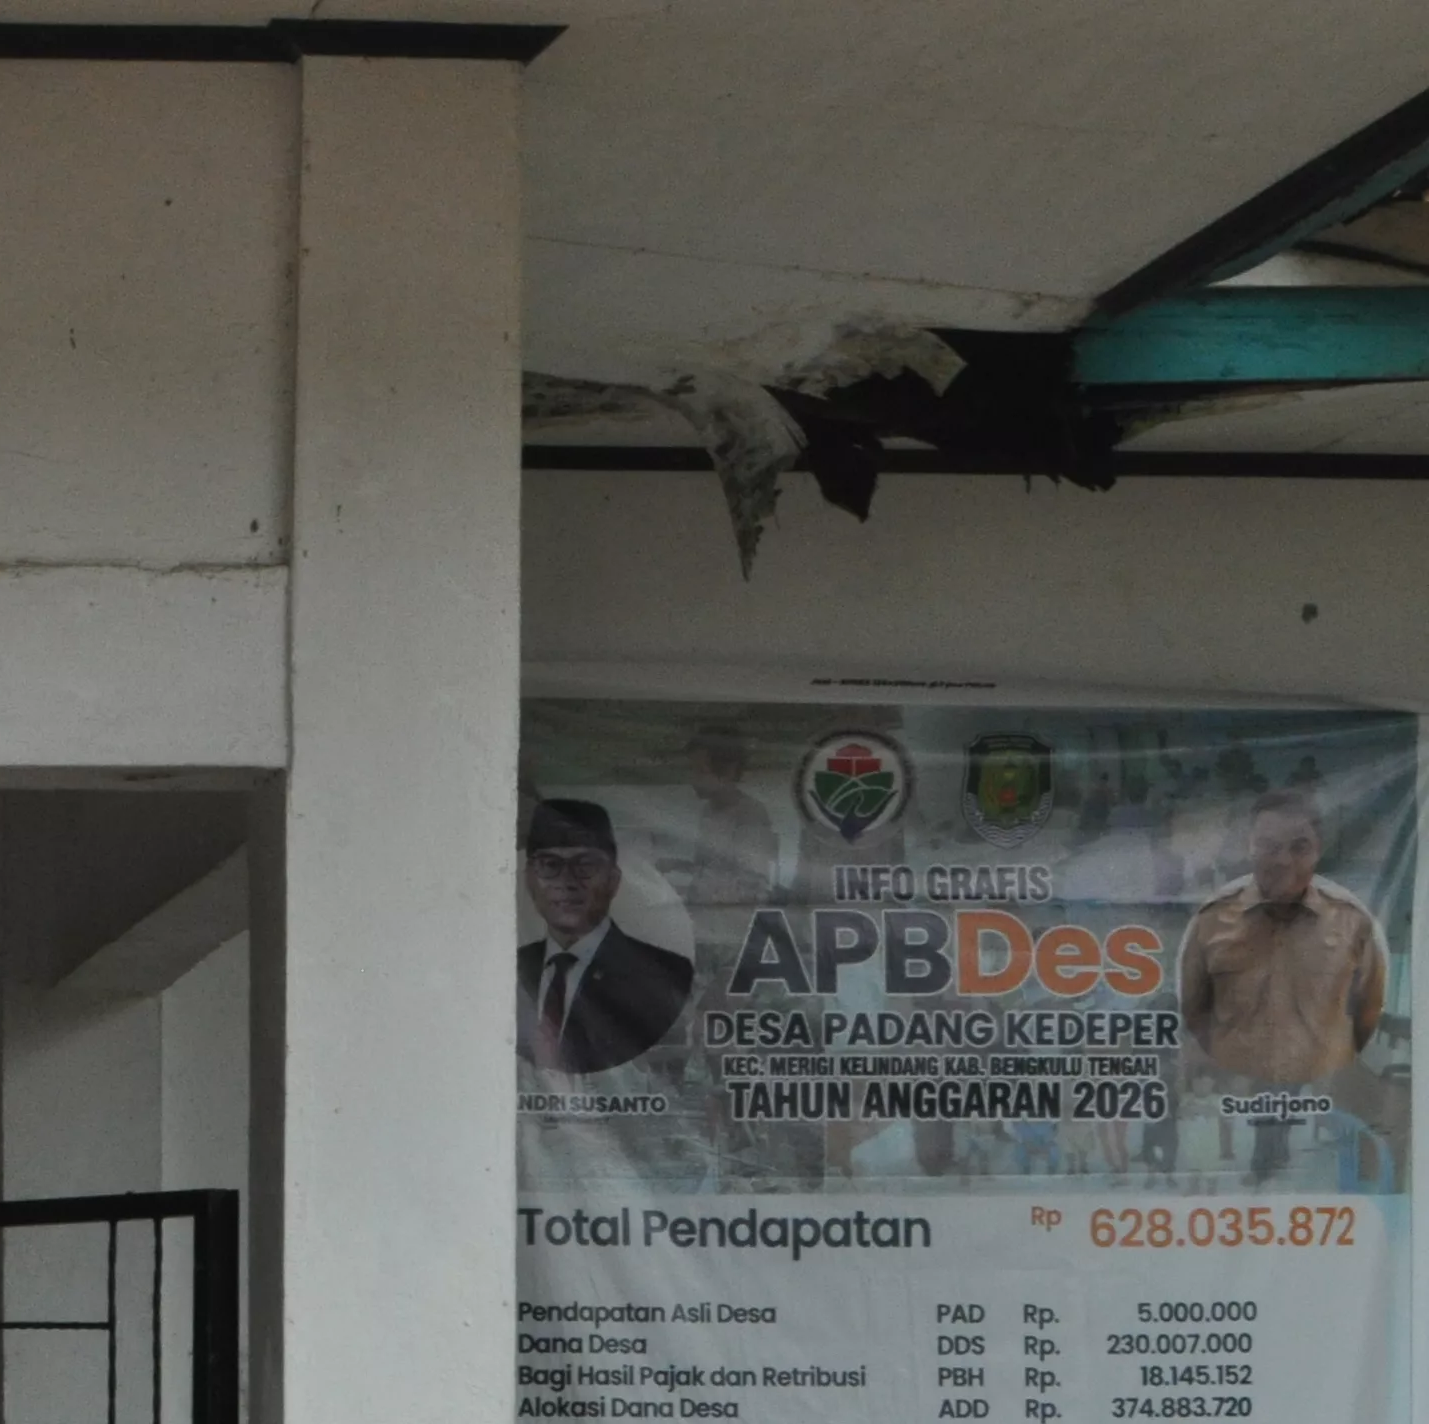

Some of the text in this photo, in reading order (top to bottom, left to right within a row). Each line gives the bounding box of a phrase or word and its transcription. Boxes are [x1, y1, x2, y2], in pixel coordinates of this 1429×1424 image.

[835, 867, 1051, 900] INFO GRAFIS
[728, 910, 1163, 996] APBDes
[705, 1012, 1179, 1047] DESA PADANG KEDEPER
[724, 1056, 1157, 1076] KEC. MERIGI KELINDANG KAB. BENGKULU TENGAH
[569, 1096, 667, 1113] SUSANTO
[729, 1081, 1165, 1119] TAHUN ANGGARAN 2026
[1221, 1094, 1331, 1119] Sudirjono
[517, 1206, 1355, 1261] Total Pendapatan Rp 628.035.872
[518, 1302, 1258, 1329] Pendapatan Asli Desa PAD Rp. 5.000.000
[518, 1333, 1253, 1361] Dana Desa DDS Rp. 230.007.000
[518, 1365, 1253, 1393] Bagi Hasil Pajak dan Retribusi PBH Rp. 18.145.152
[518, 1397, 1253, 1424] Alokasi Dana Desa ADD Rp. 374.883.720
